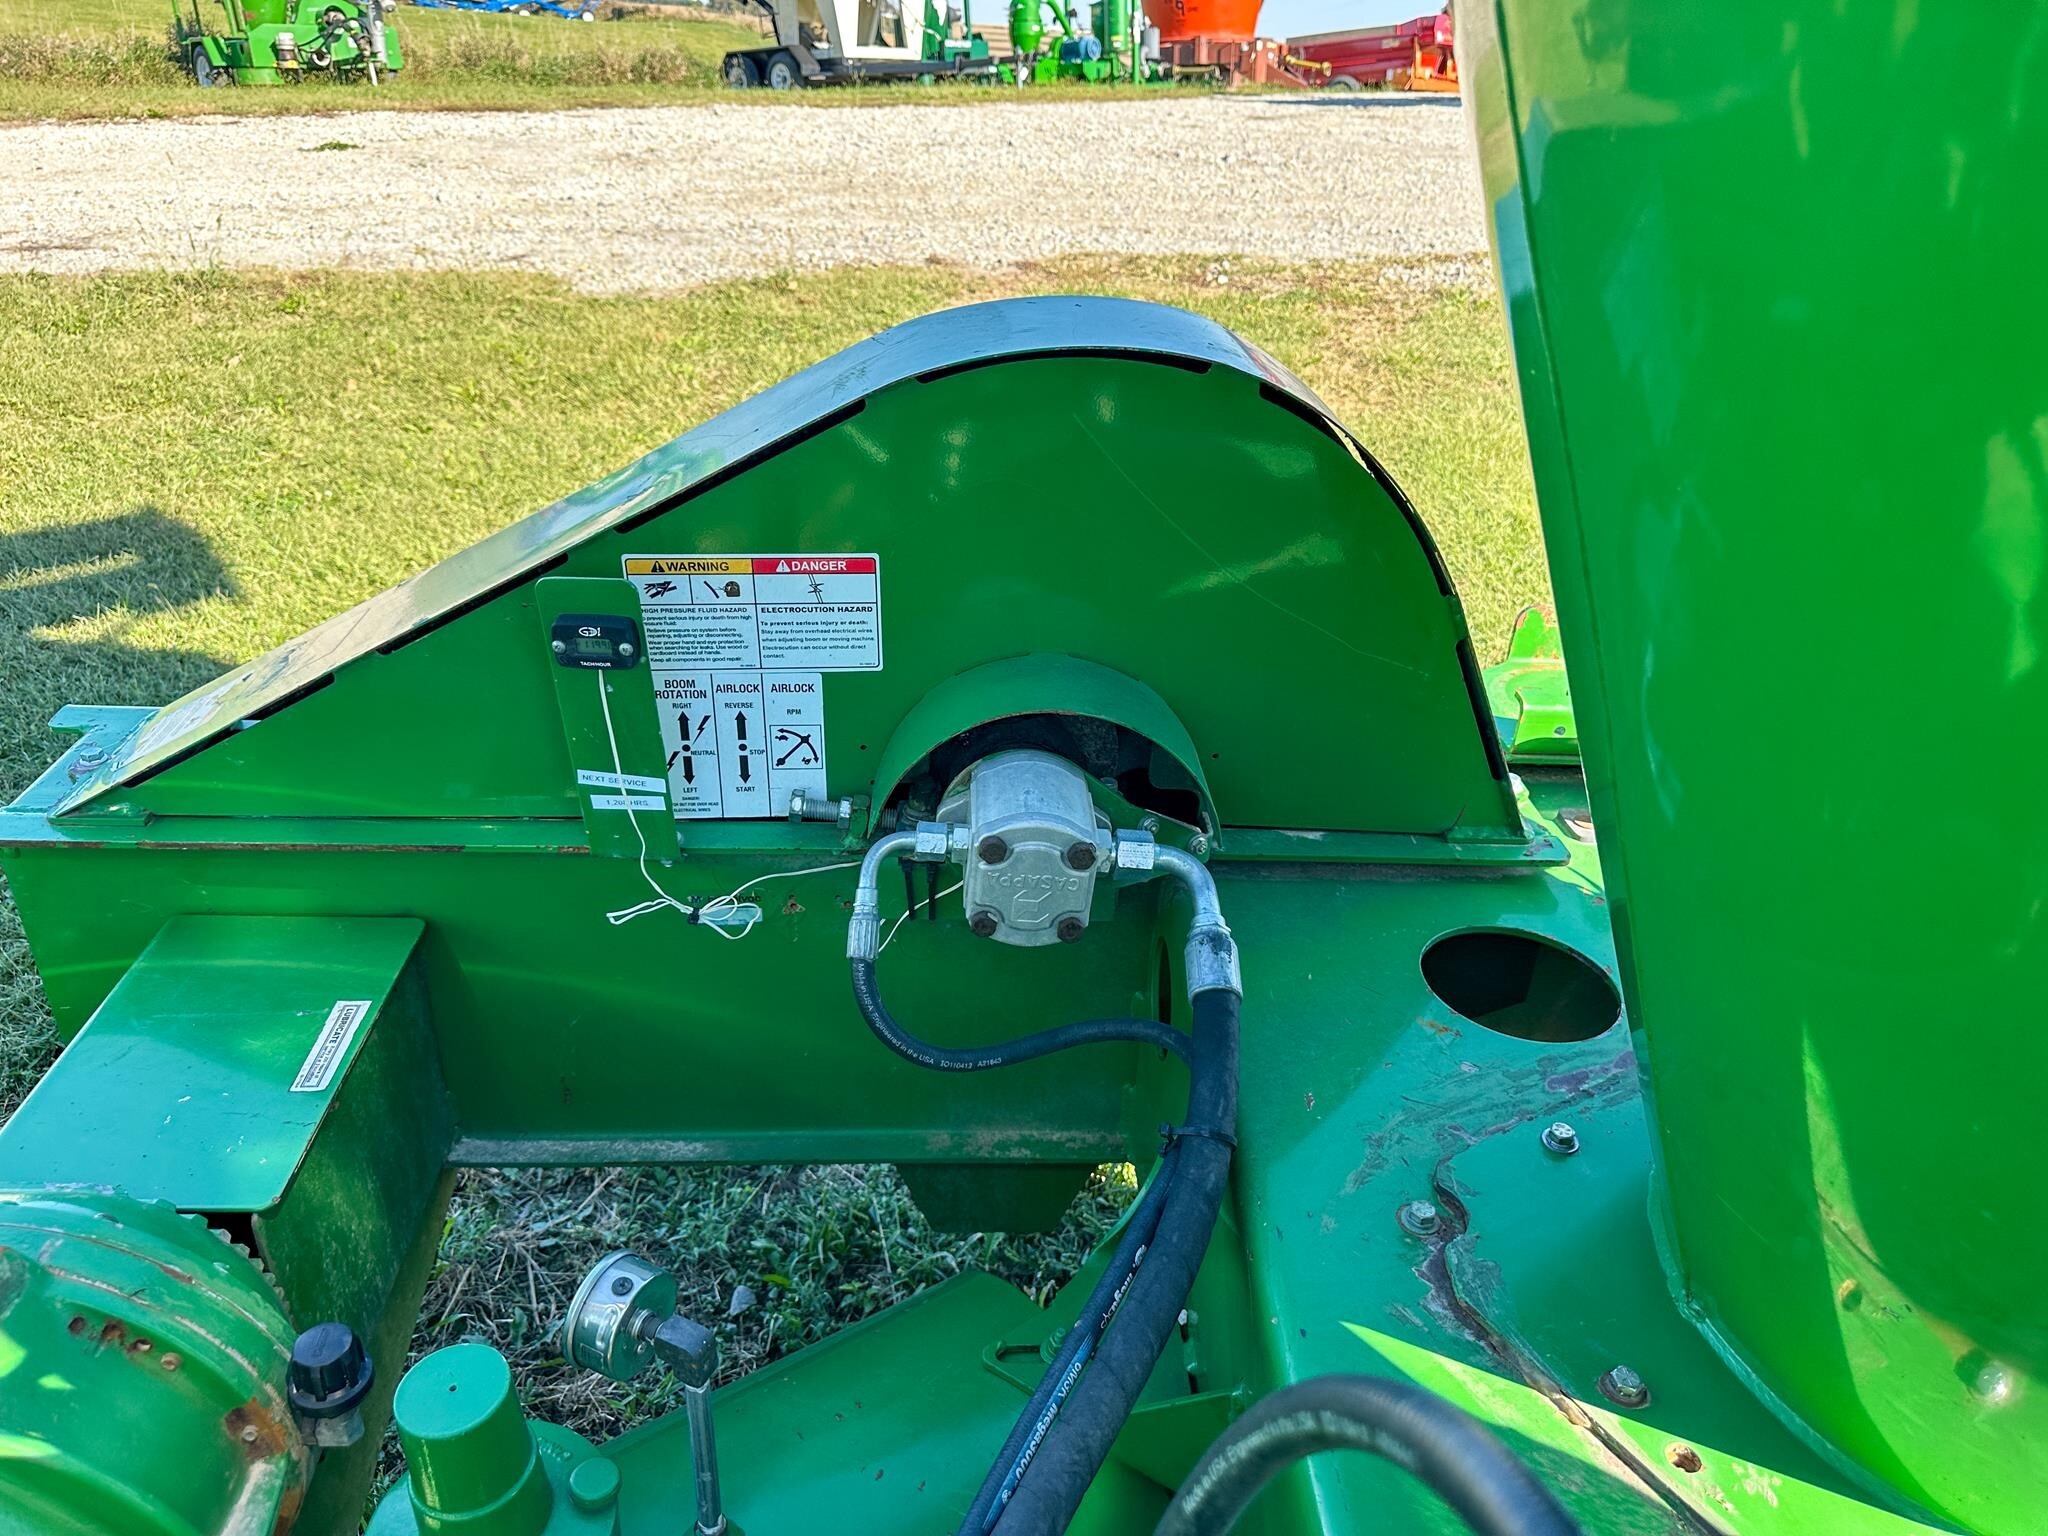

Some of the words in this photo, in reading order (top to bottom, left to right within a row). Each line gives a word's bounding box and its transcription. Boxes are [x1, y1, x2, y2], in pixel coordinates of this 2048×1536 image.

[666, 561, 729, 572] WARNING
[791, 561, 847, 571] DANGER
[664, 679, 696, 689] BOOM
[715, 684, 760, 693] AIRLOCK
[770, 683, 815, 693] AIRLOCK
[655, 690, 707, 699] ROTATION
[582, 774, 605, 782] NEXT
[987, 872, 1080, 891] CASAPPA
[329, 1008, 354, 1044] LUBRICATE
[863, 994, 874, 1011] USA
[918, 1054, 934, 1064] USA
